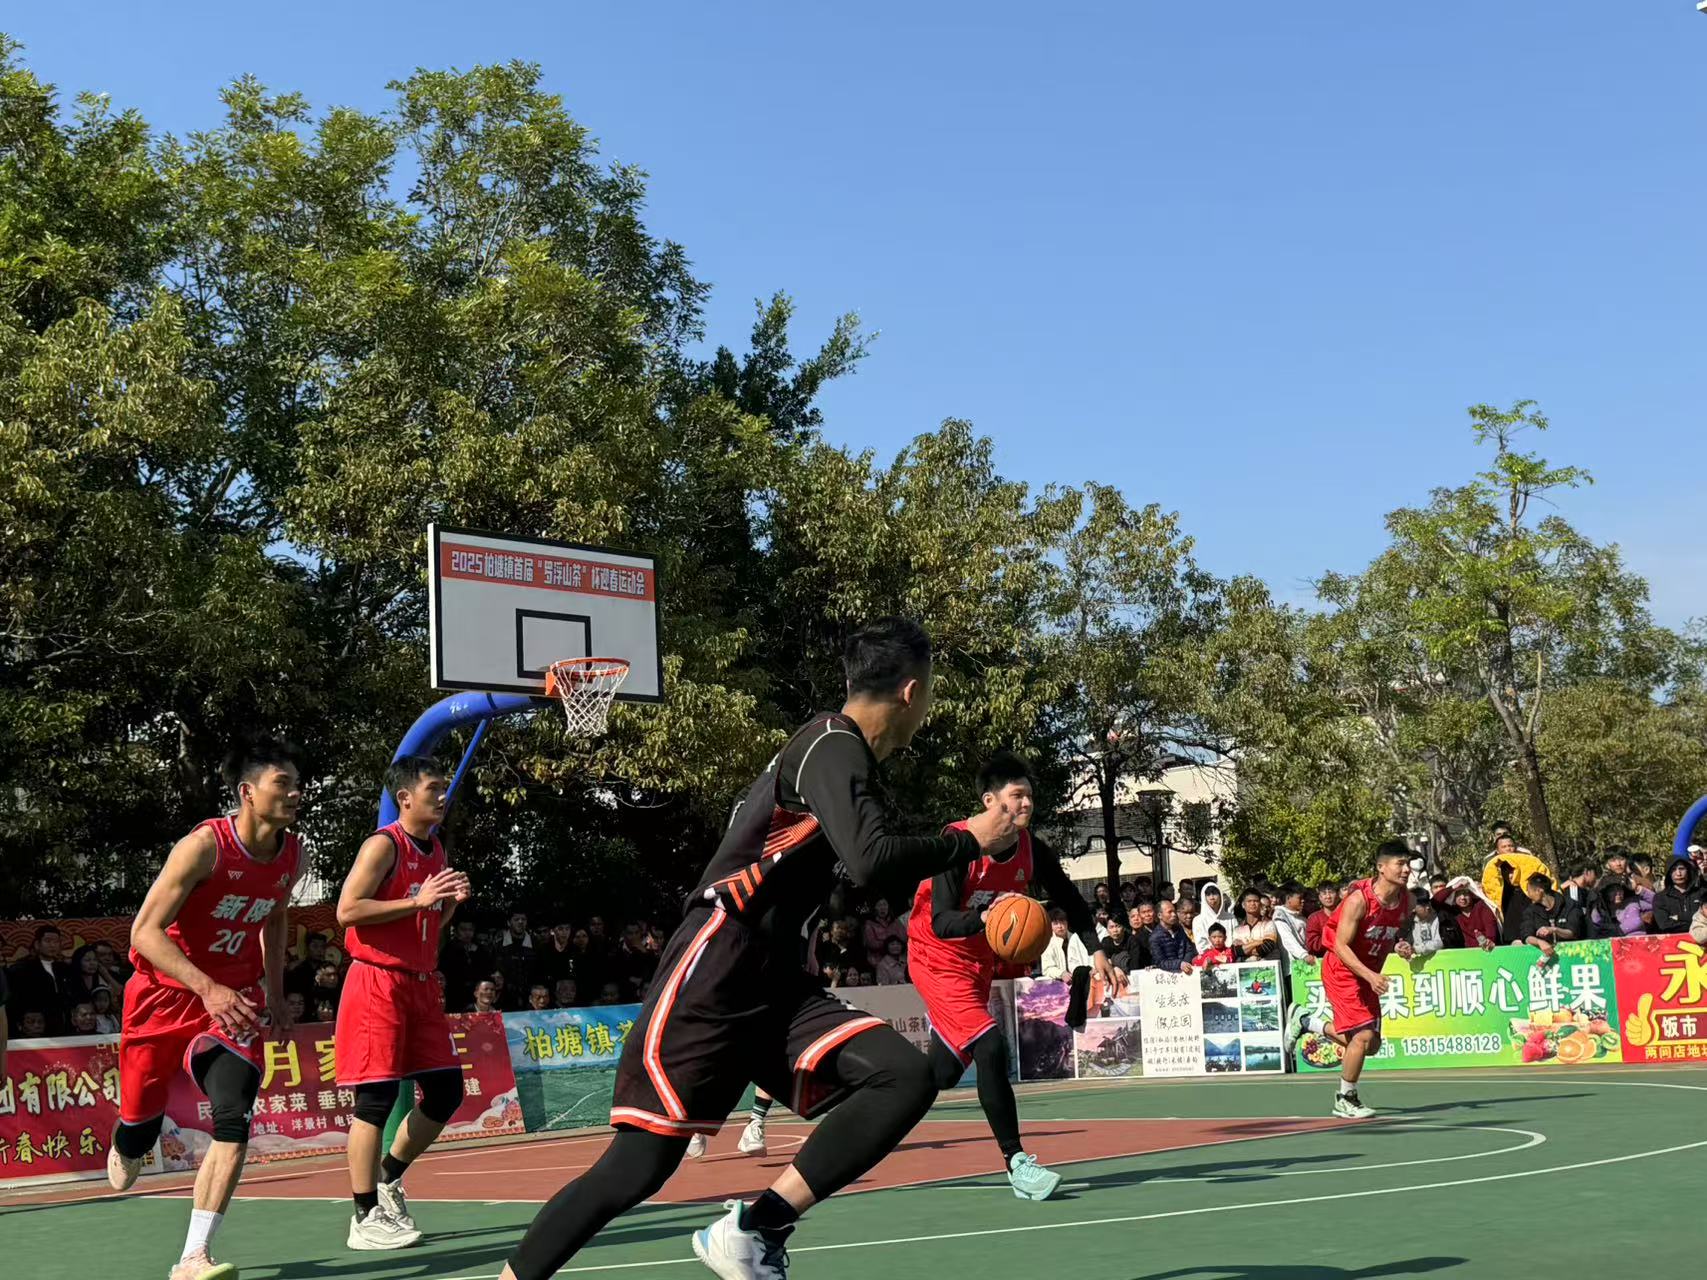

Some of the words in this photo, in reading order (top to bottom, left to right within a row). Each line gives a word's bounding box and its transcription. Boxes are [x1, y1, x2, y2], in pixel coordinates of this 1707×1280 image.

[208, 928, 246, 955] 20
[1305, 964, 1607, 1020] 买果到顺心鲜果
[1661, 1015, 1698, 1038] 饭市
[1402, 1035, 1501, 1055] 15815488128
[318, 1088, 356, 1110] 垂钓
